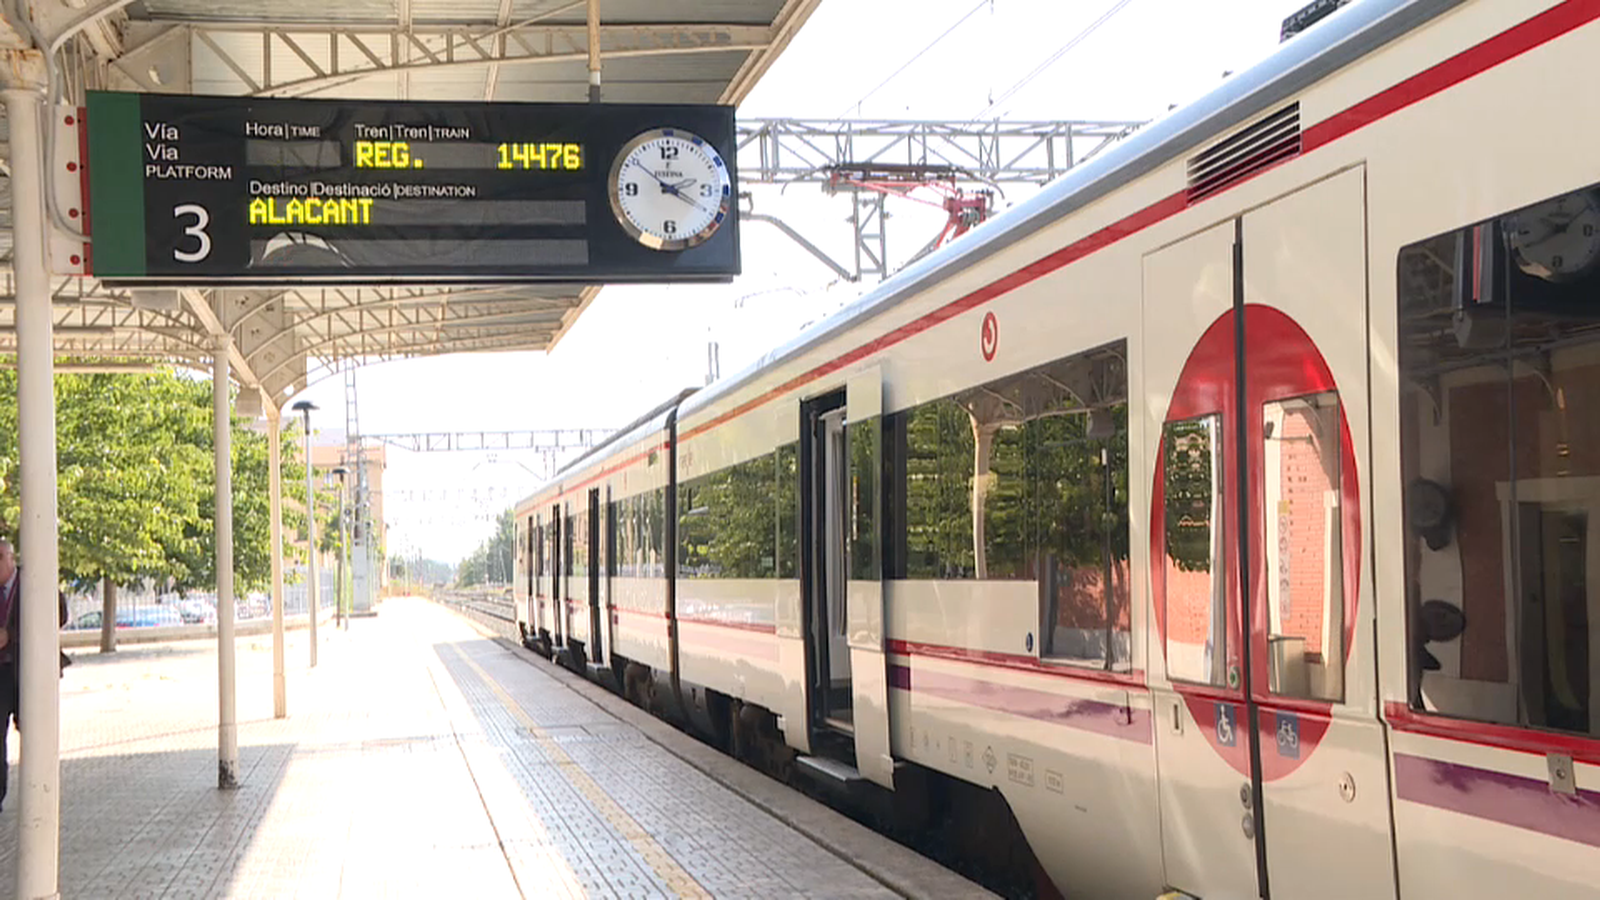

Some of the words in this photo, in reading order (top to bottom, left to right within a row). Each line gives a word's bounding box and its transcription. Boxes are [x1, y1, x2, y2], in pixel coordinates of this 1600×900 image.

[145, 122, 179, 140] Vía
[146, 143, 179, 160] Via
[356, 141, 423, 168] REG.
[497, 143, 581, 170] 14476
[660, 146, 679, 160] 12
[145, 165, 232, 179] PLATFORM
[625, 182, 638, 197] 9
[700, 184, 713, 198] 3
[249, 197, 373, 224] ALACANT
[174, 204, 212, 262] 3
[663, 220, 676, 234] 6
